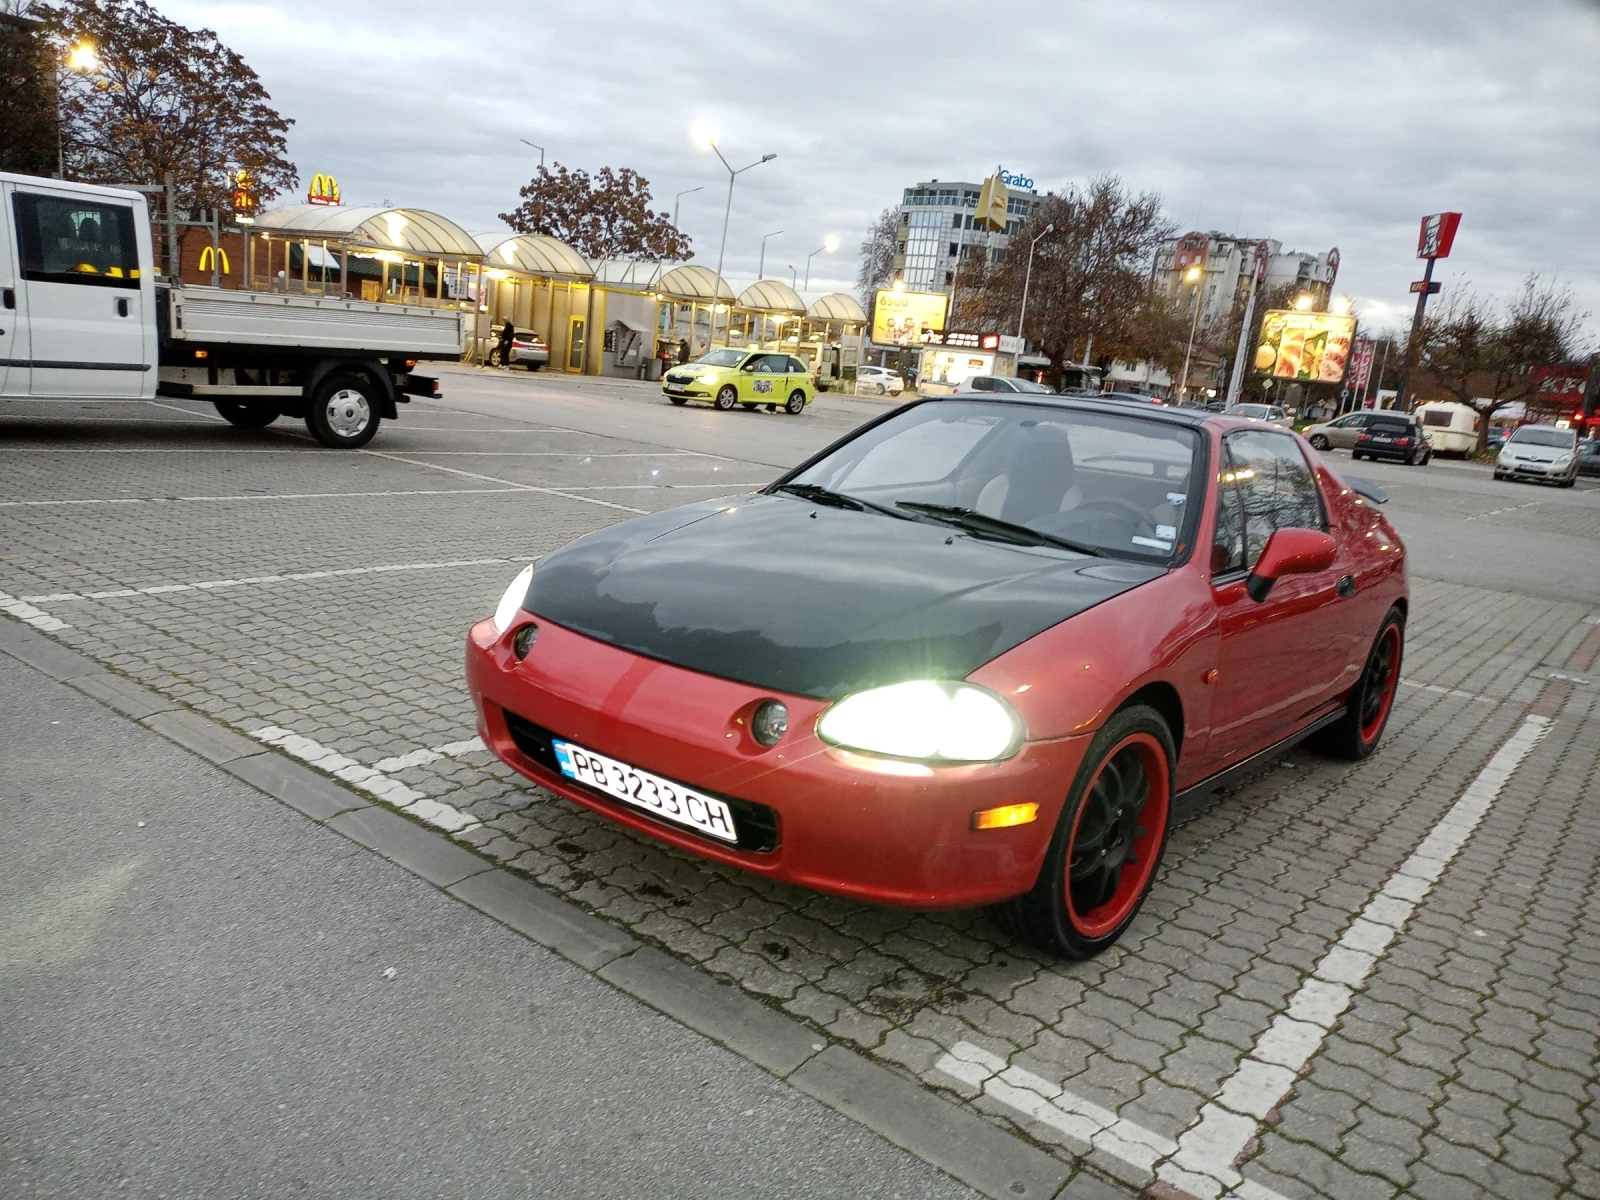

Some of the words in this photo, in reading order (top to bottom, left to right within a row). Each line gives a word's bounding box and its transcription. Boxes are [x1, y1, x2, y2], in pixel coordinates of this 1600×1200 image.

[1001, 170, 1034, 188] Grabo
[1411, 282, 1425, 291] KFC
[572, 751, 608, 786] PB
[612, 766, 680, 815] 3233
[686, 795, 731, 833] CH
